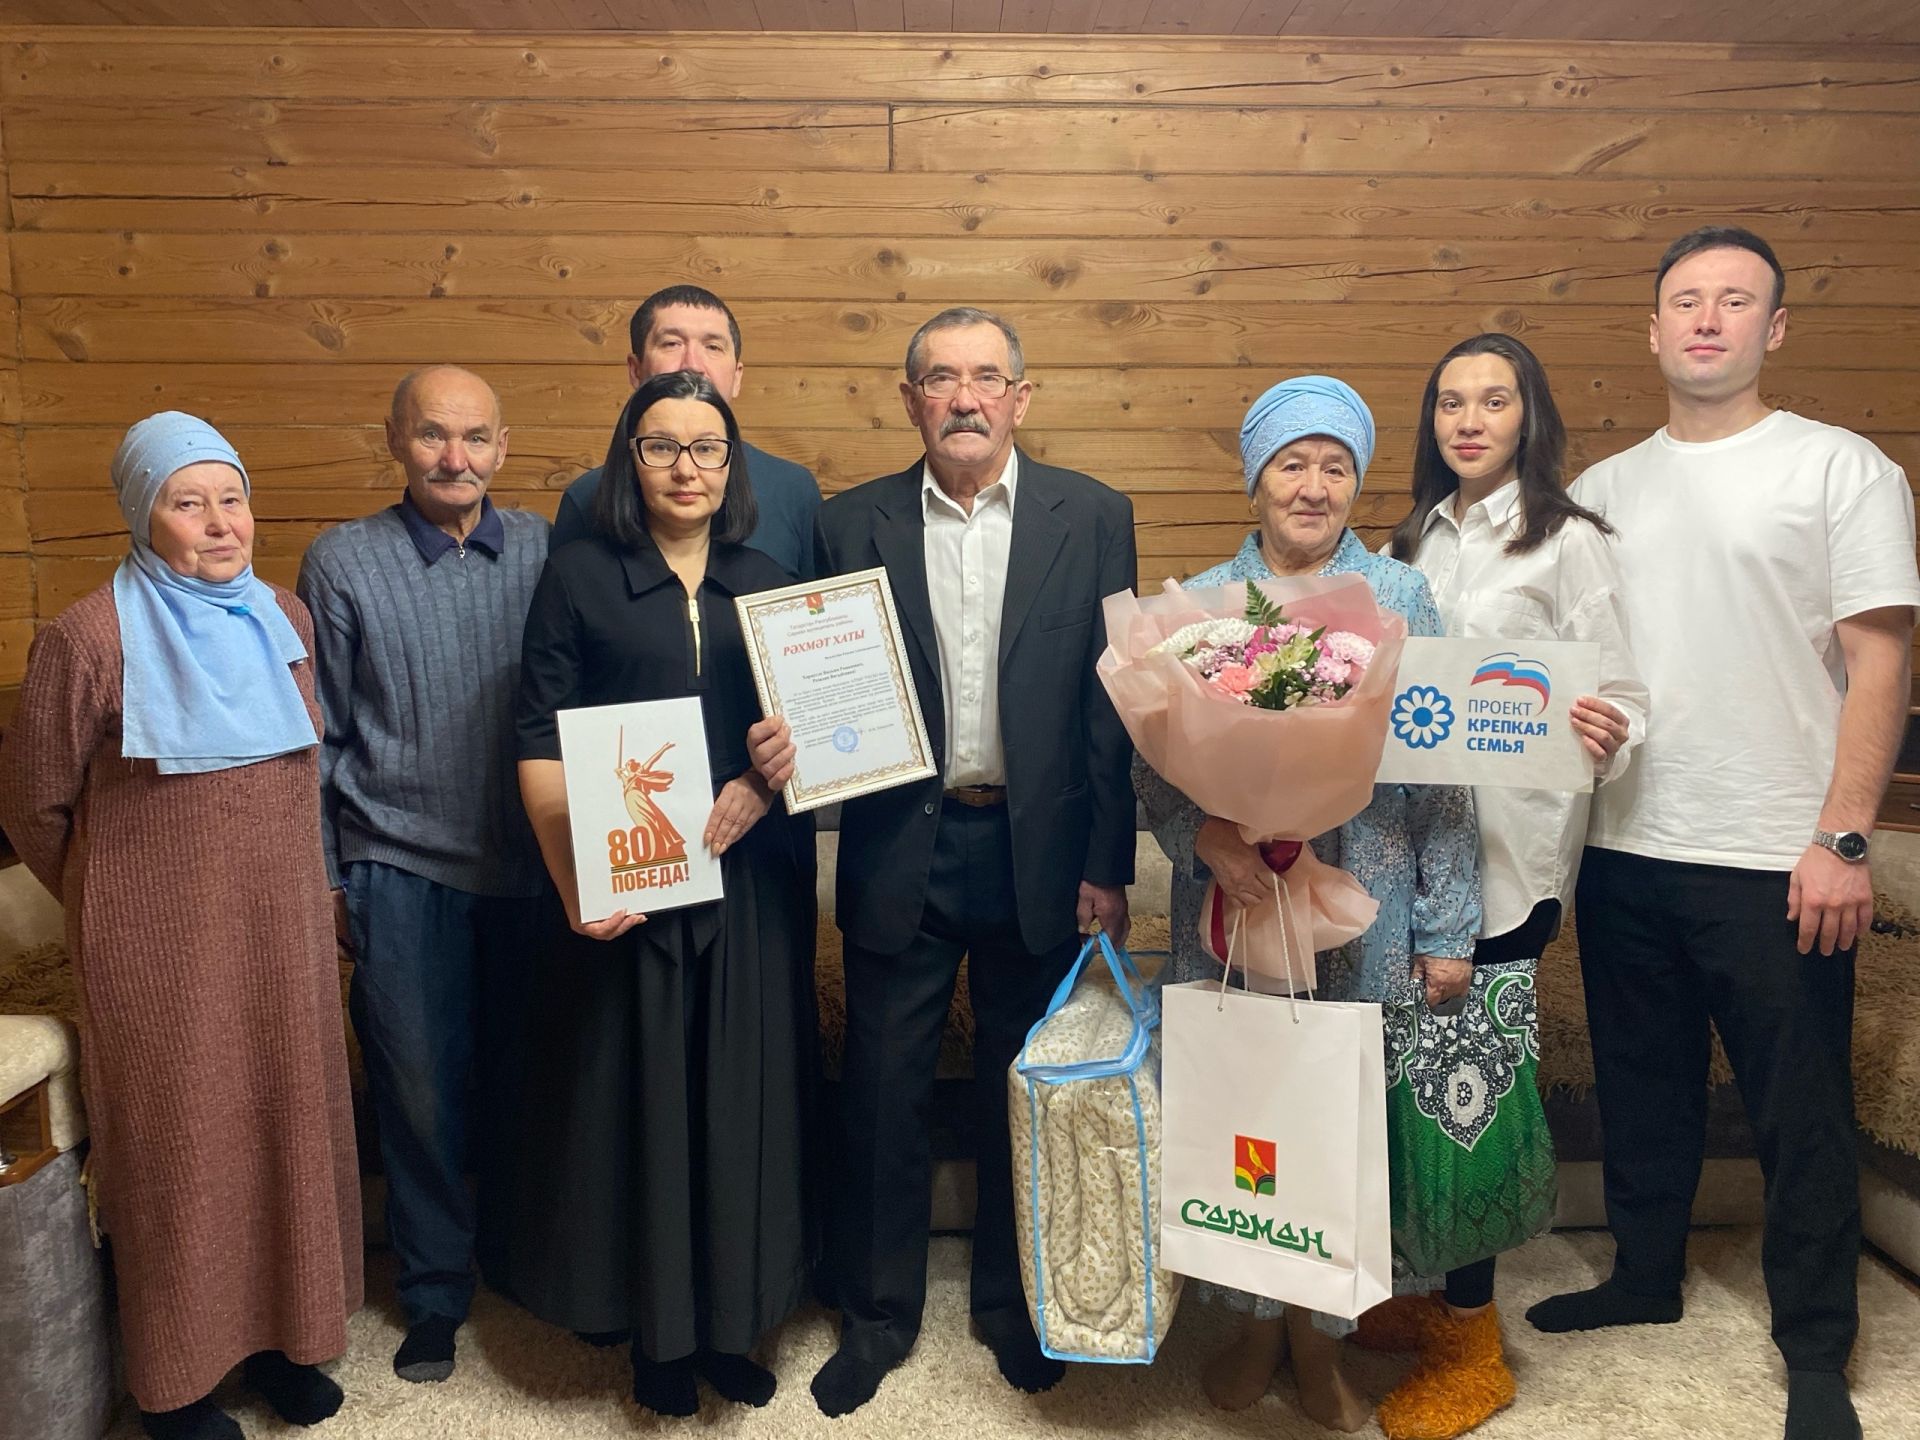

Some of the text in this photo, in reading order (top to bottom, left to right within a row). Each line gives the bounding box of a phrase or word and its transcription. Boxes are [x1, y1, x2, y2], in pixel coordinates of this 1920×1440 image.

[783, 637, 831, 656] РӘХМӘТ
[833, 629, 865, 646] ХАТЫ
[1468, 699, 1533, 716] ПРОЕКТ
[1467, 718, 1548, 736] КРЕПКАЯ
[1466, 737, 1525, 753] СЕМЬЯ
[607, 826, 652, 867] 80
[611, 863, 690, 894] ПОБЕДА!
